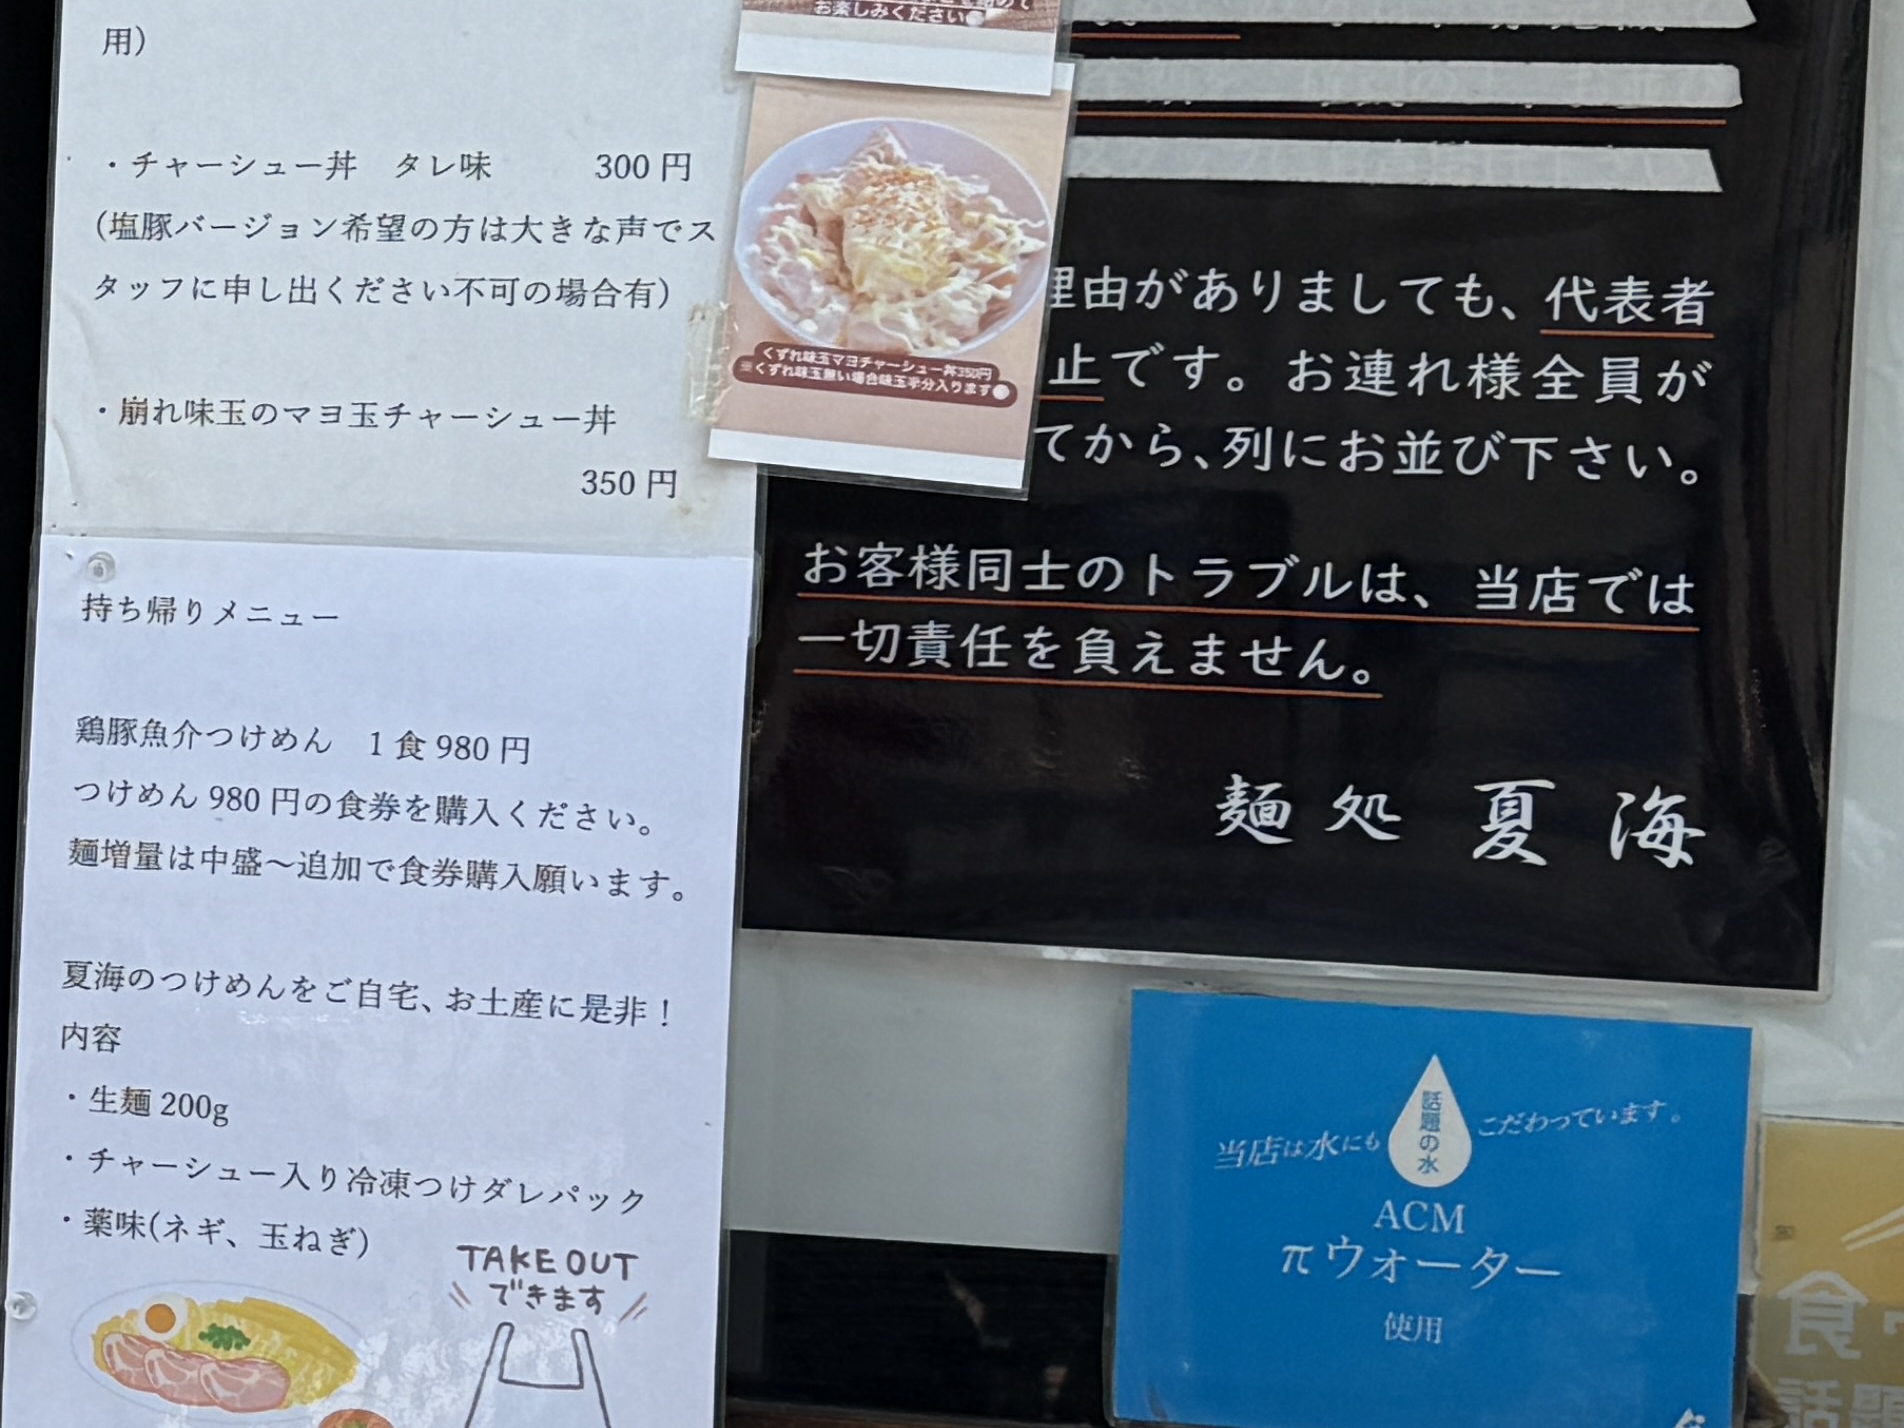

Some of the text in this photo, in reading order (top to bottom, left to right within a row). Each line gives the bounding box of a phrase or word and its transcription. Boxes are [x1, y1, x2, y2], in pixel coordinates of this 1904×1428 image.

[395, 151, 492, 180] タレ味
[93, 275, 671, 310] タッフに申し出ください不可の場合有)
[800, 540, 1696, 617] お客様同士のトラブルは、当店では
[82, 595, 339, 628] 持ち帰りメニュー
[797, 621, 1373, 685] 一切責任を負えません。
[75, 716, 332, 754] 鶏豚魚介つけめん
[63, 960, 672, 1027] 夏海のつけめんをご自宅、お土産に是非！
[61, 1022, 122, 1053] 内容
[1417, 1089, 1443, 1174] 話題の水
[1476, 1099, 1682, 1136] こだわっています。
[1215, 1131, 1380, 1169] 当店は水にも
[1374, 1200, 1466, 1234] ACM
[457, 1244, 638, 1280] TAKE OUT
[490, 1281, 605, 1315] できます
[1384, 1312, 1443, 1345] 使用
